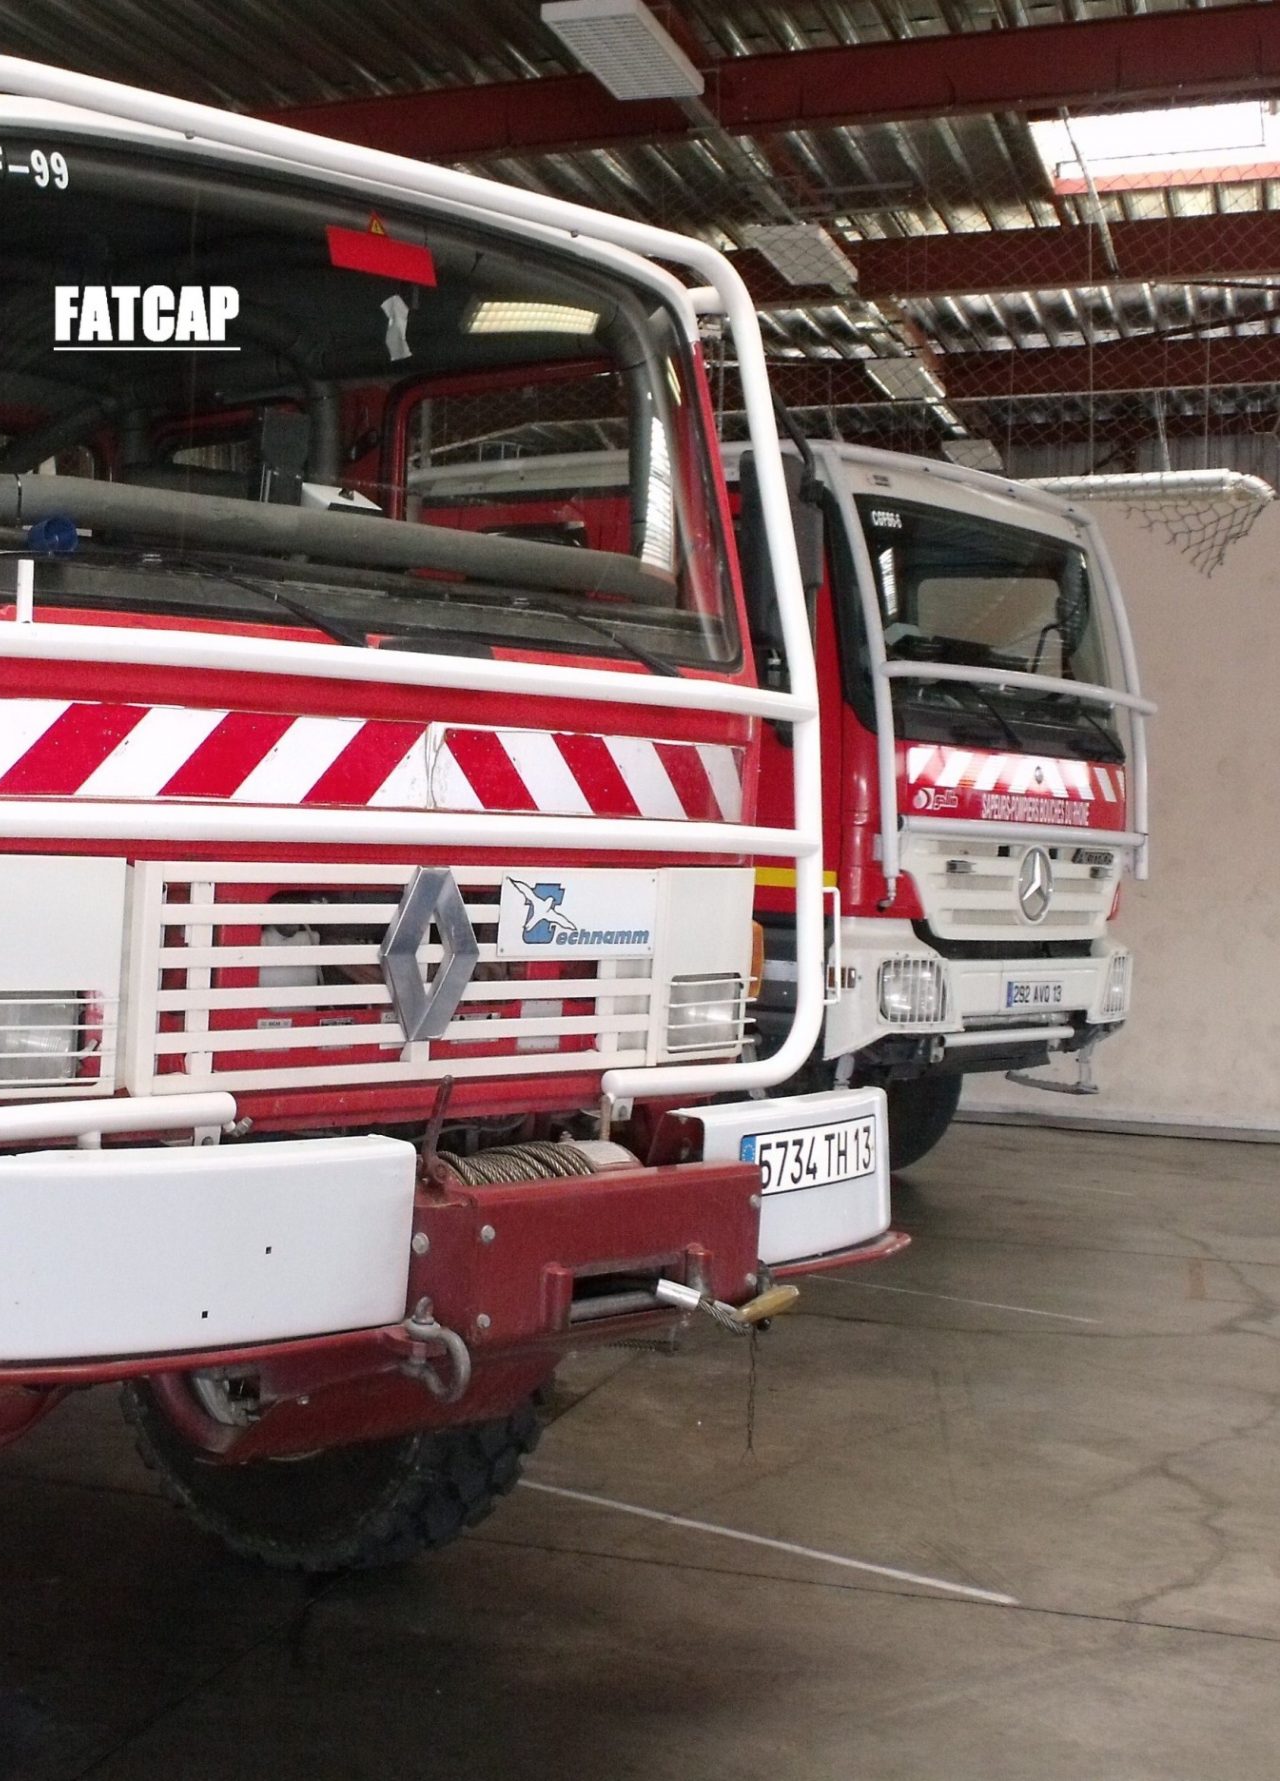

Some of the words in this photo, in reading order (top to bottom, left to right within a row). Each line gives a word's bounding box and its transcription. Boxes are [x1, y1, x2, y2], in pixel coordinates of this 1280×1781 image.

[1013, 985, 1031, 1003] 292
[1053, 985, 1063, 1002] 13
[759, 1136, 818, 1190] 5734
[824, 1130, 848, 1178] TH
[853, 1125, 871, 1171] 13
